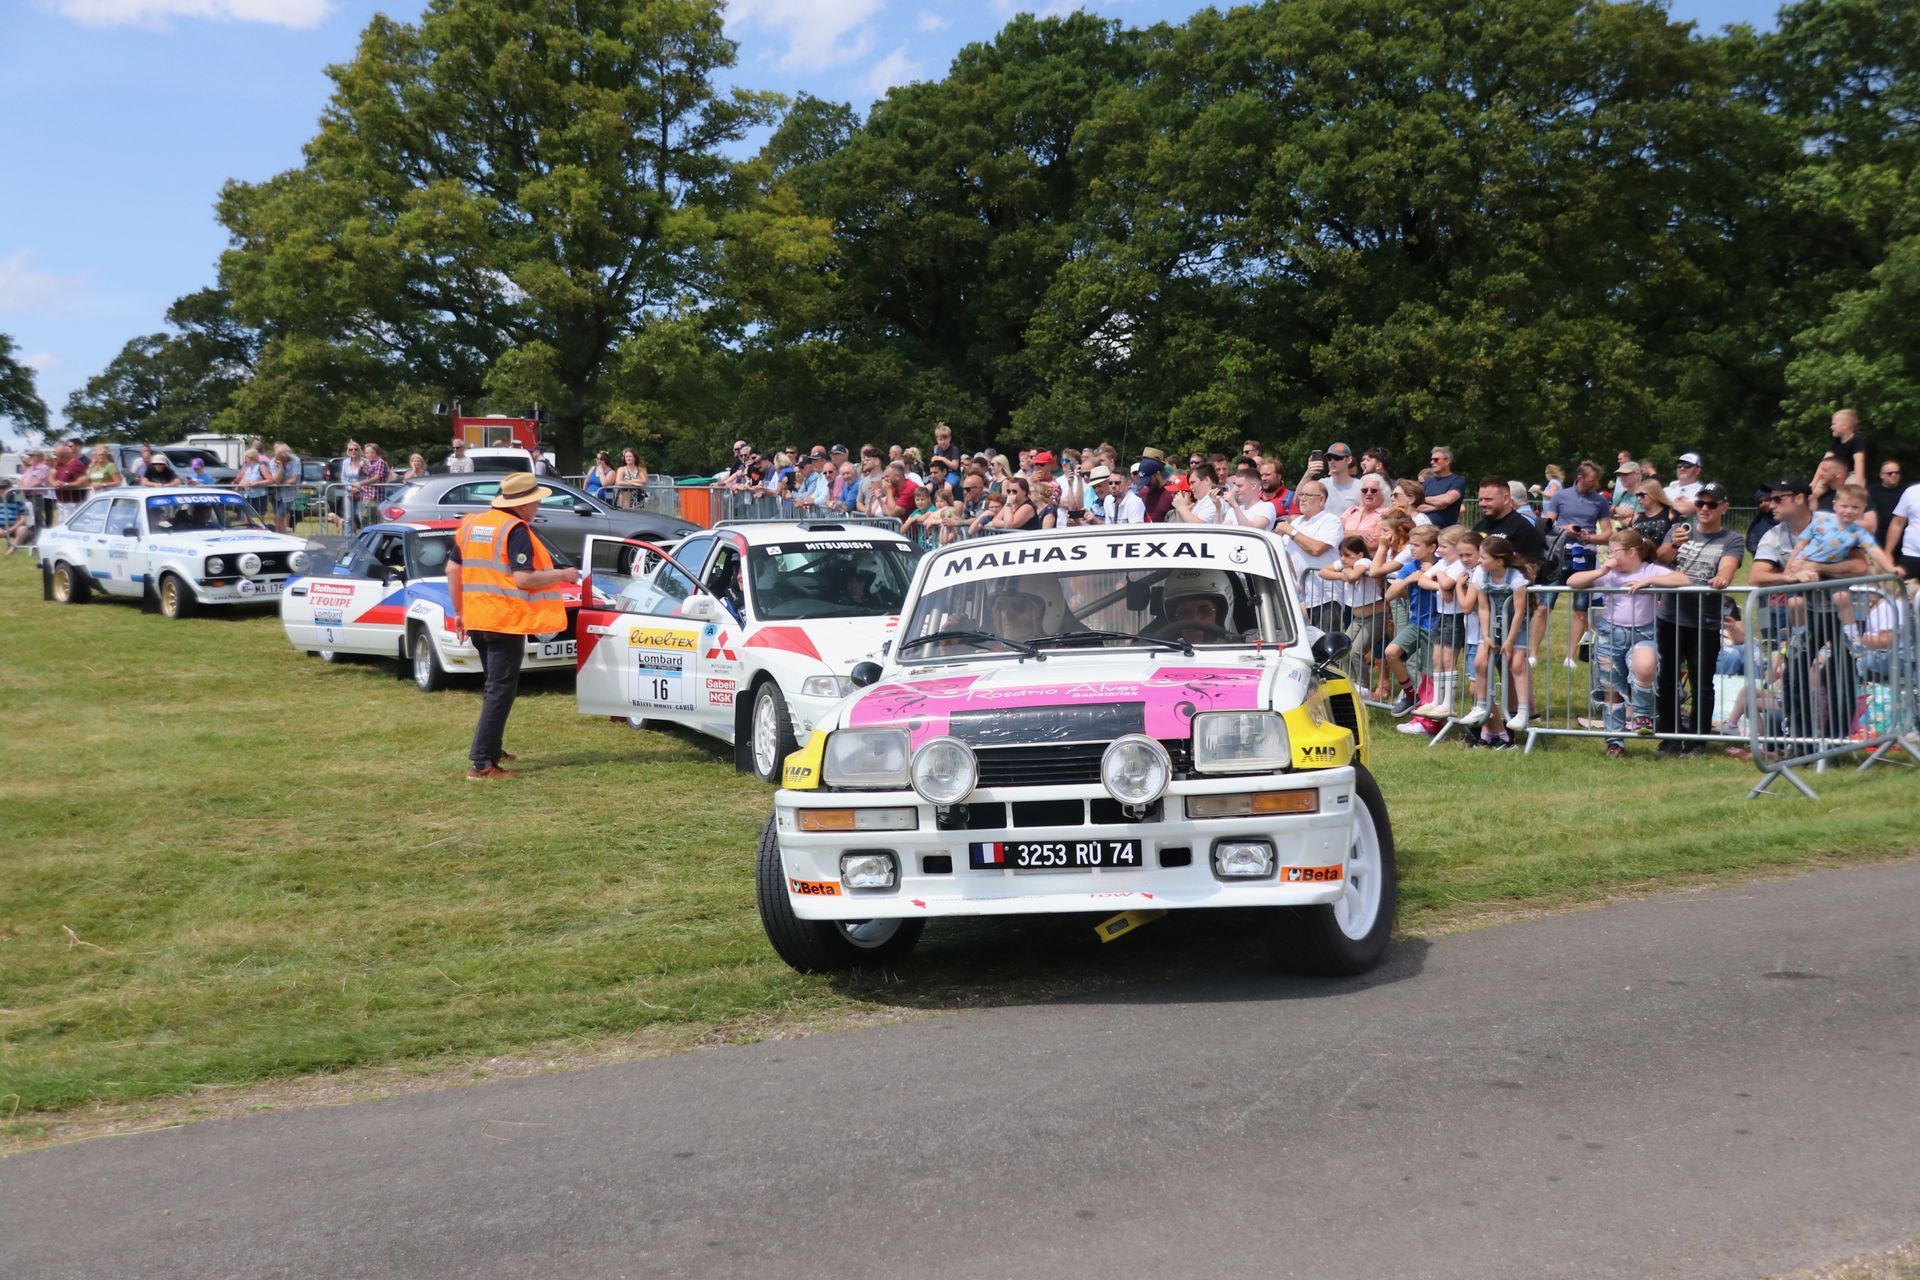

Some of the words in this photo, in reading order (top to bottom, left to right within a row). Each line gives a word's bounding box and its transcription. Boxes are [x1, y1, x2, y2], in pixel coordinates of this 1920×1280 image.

[176, 496, 221, 504] ESCORT
[805, 542, 873, 551] MITSUBISHI
[943, 545, 1088, 577] MALHAS
[1106, 542, 1215, 559] TEXAL
[314, 584, 351, 594] Rothmans
[309, 596, 353, 608] L'EQUIPE
[314, 609, 343, 619] Lombard
[326, 628, 334, 643] 3
[544, 643, 563, 656] CJI
[638, 653, 683, 665] Lombard
[652, 678, 669, 700] 16
[707, 679, 735, 690] Sabelt
[1065, 683, 1140, 695] Alves
[710, 692, 732, 703] NGK
[1017, 844, 1067, 866] 3253
[1076, 843, 1102, 865] RU
[1109, 842, 1134, 864] 74
[1303, 868, 1338, 881] Beta
[801, 882, 835, 895] Beta
